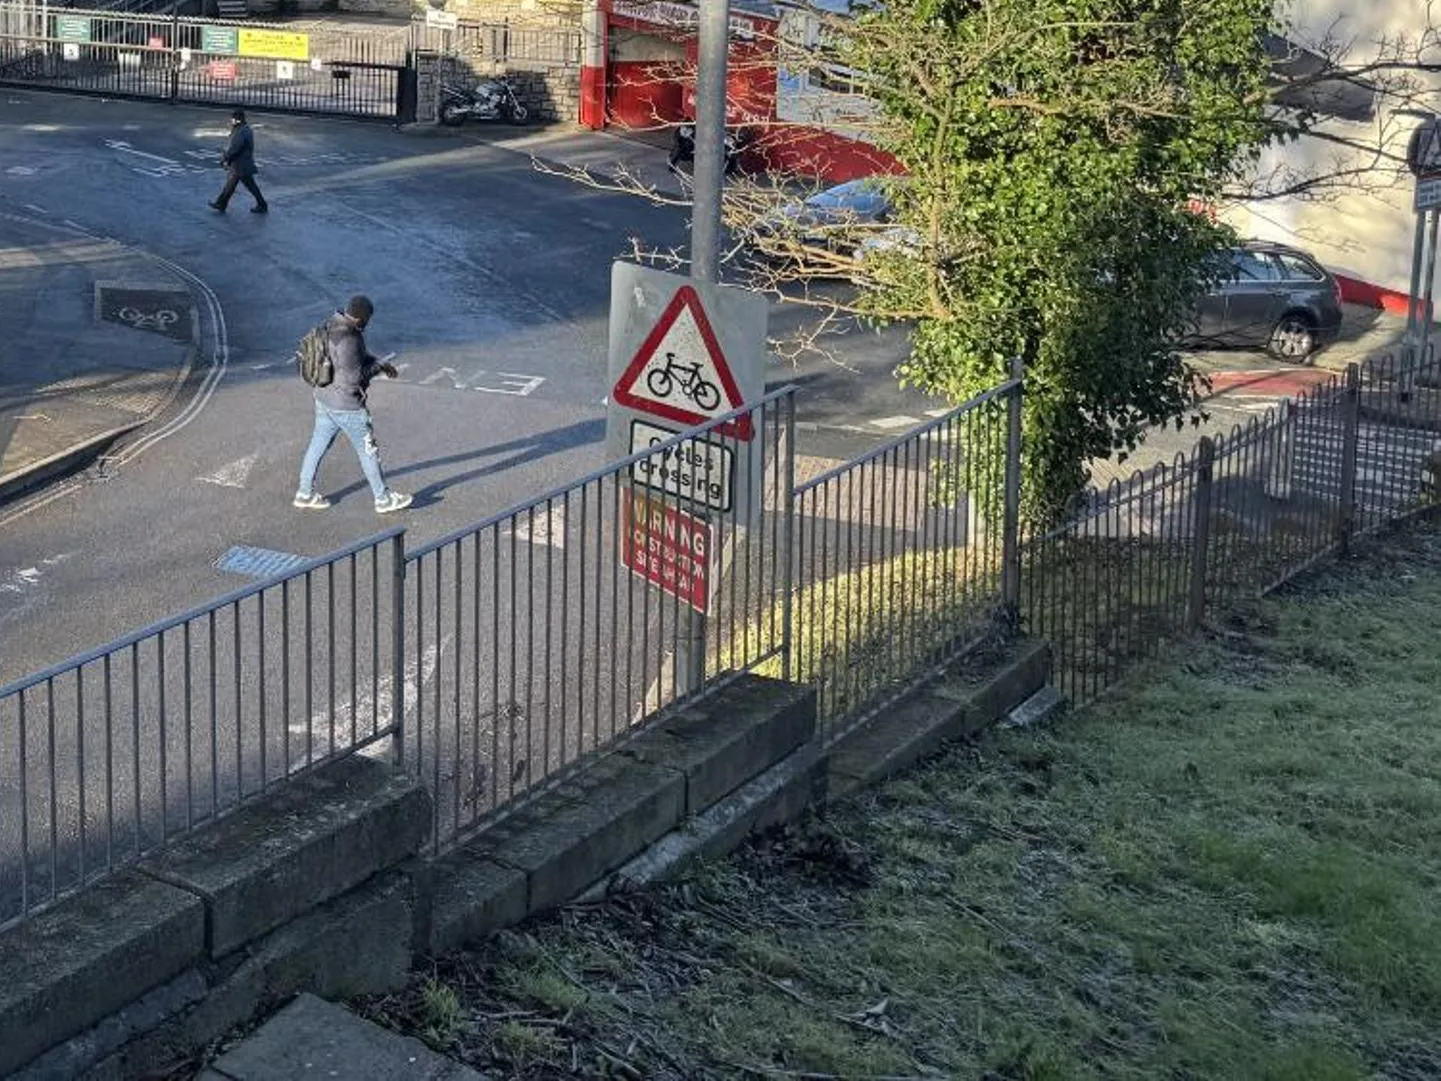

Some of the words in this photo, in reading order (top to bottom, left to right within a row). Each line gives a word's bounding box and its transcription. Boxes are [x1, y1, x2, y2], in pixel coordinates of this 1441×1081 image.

[639, 459, 722, 500] crossng
[628, 496, 705, 557] WRNNG
[629, 527, 705, 580] ONSTRUTIN
[635, 550, 659, 574] SIE
